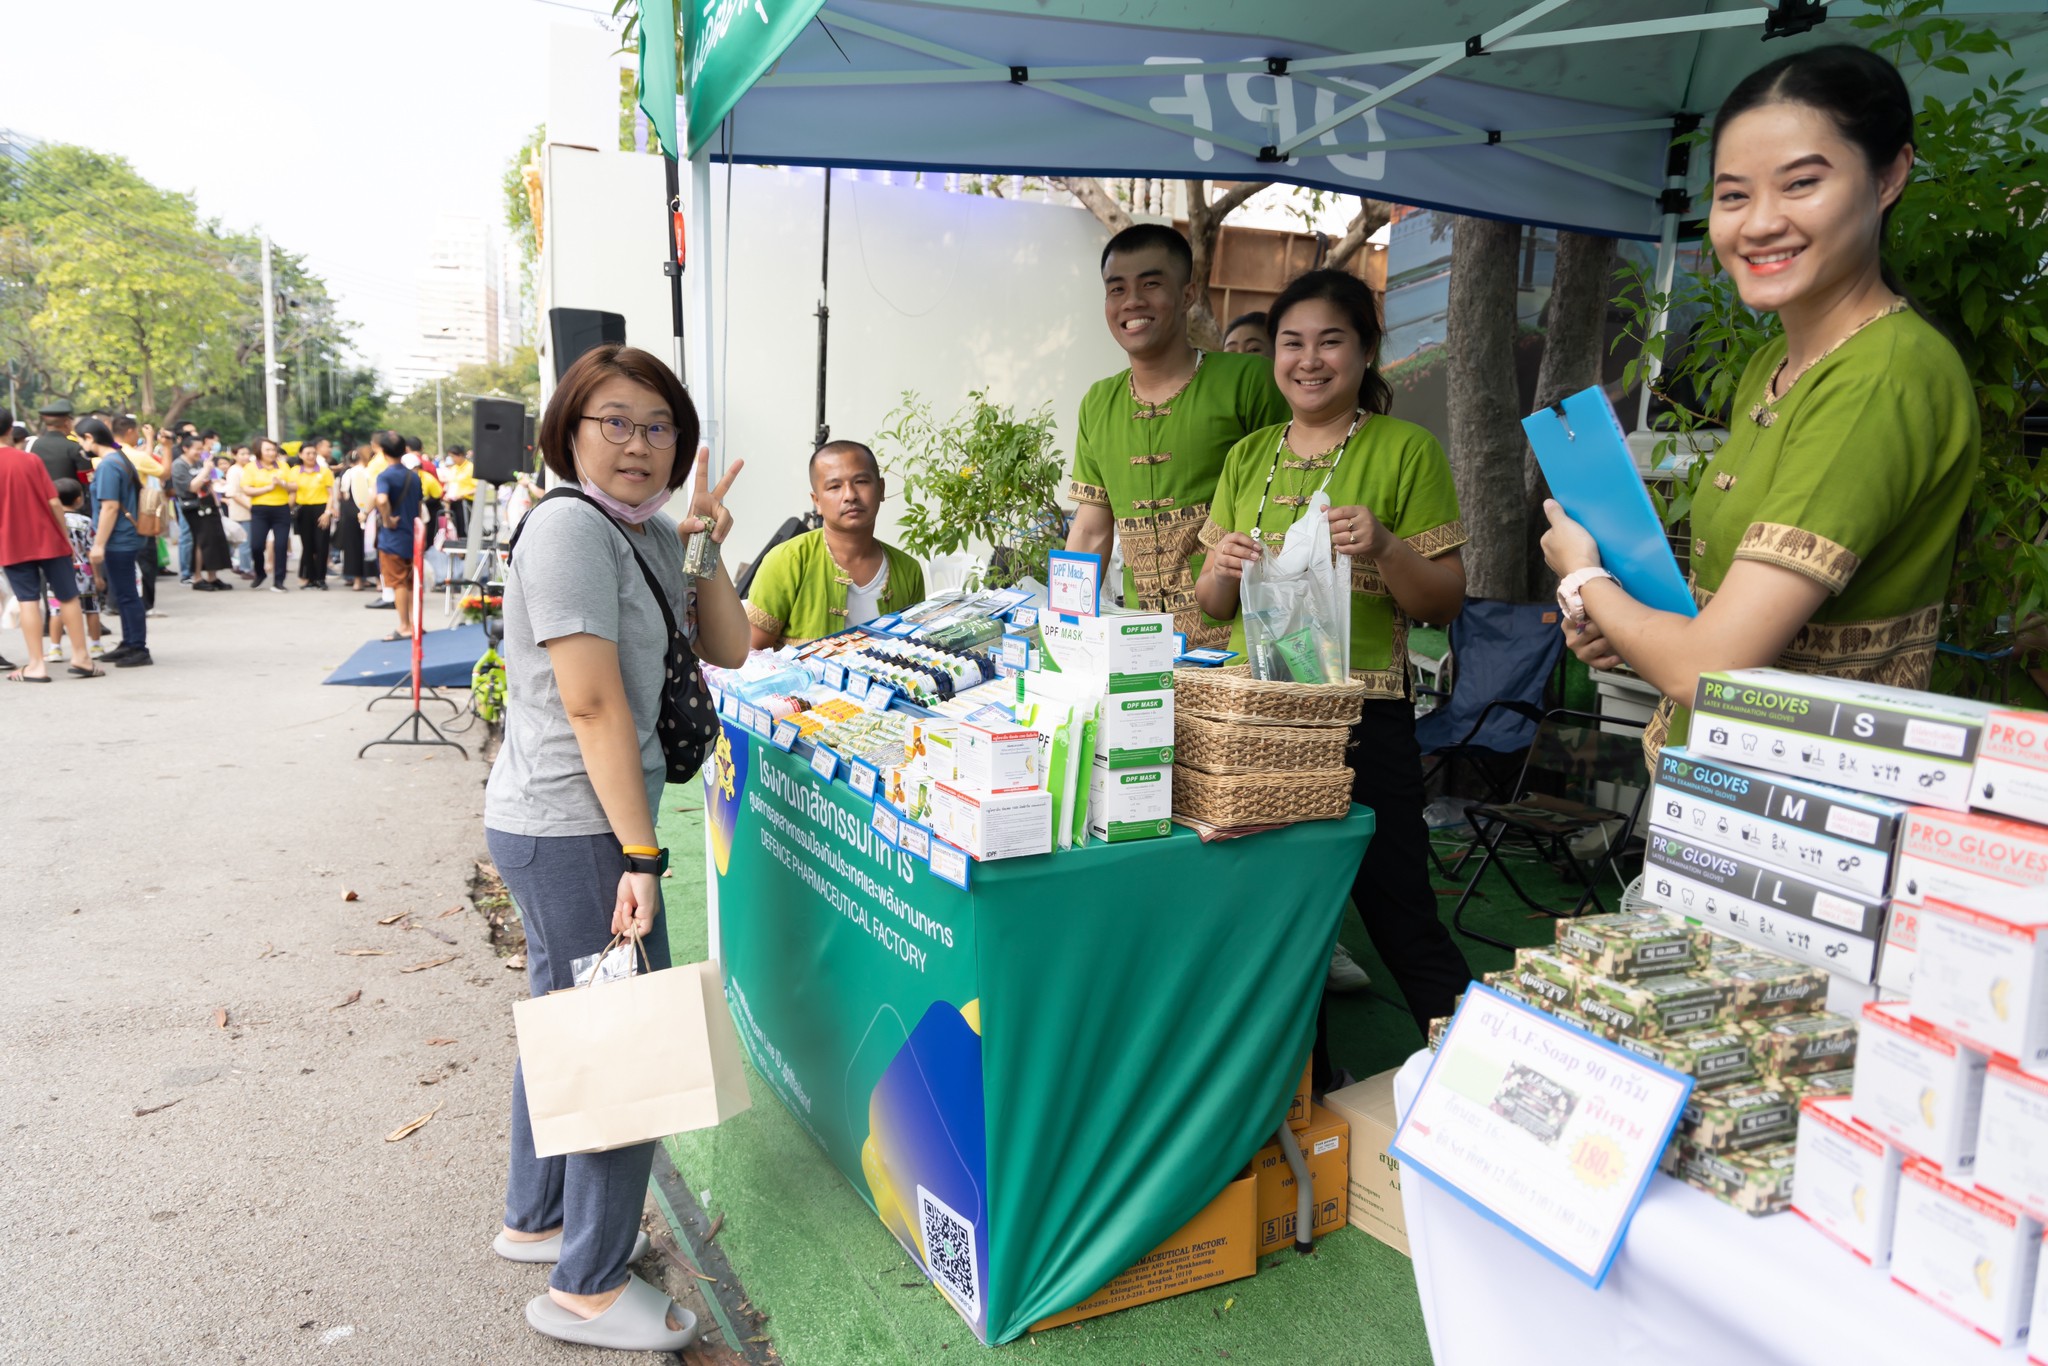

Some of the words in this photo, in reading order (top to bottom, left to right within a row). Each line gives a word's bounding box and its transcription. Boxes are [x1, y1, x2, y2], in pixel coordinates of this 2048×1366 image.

[1045, 625, 1059, 637] DPF
[1061, 628, 1083, 641] MASK
[1141, 700, 1158, 708] MASK
[1703, 700, 1720, 708] LATEX
[1722, 703, 1766, 717] EXAMINATION
[1768, 712, 1795, 723] GLOVES
[1742, 689, 1810, 715] GLOVES
[1853, 713, 1875, 737] S
[1989, 724, 2036, 747] PRO
[1039, 733, 1050, 748] PF
[1662, 774, 1676, 783] LATEX
[1677, 778, 1713, 794] EXAMINATION
[1715, 790, 1736, 801] GLOVES
[1694, 767, 1750, 794] GLOVES
[1782, 795, 1806, 821] M
[1910, 822, 1952, 846] PRO
[1959, 835, 2048, 873] GLOVES
[1652, 852, 1665, 861] LATEX
[1666, 856, 1702, 874] EXAMINATION
[1703, 870, 1724, 883] GLOVES
[1682, 847, 1738, 877] GLOVES
[761, 828, 792, 869] DEFENCE
[793, 855, 871, 935] PHARMACEUTICAL
[873, 917, 927, 973] FACTORY
[1772, 880, 1787, 905] L
[1895, 911, 1917, 934] PR
[1585, 1060, 1609, 1082] 90
[1262, 1157, 1276, 1168] 100
[1281, 1177, 1294, 1188] 100
[1267, 1221, 1275, 1235] 5
[1134, 1246, 1190, 1267] RMACEUTICAL
[1192, 1237, 1228, 1252] FACTORY,
[1166, 1256, 1190, 1265] ENERGY
[1192, 1249, 1216, 1259] CENTRE
[1148, 1275, 1172, 1286] Bangkok
